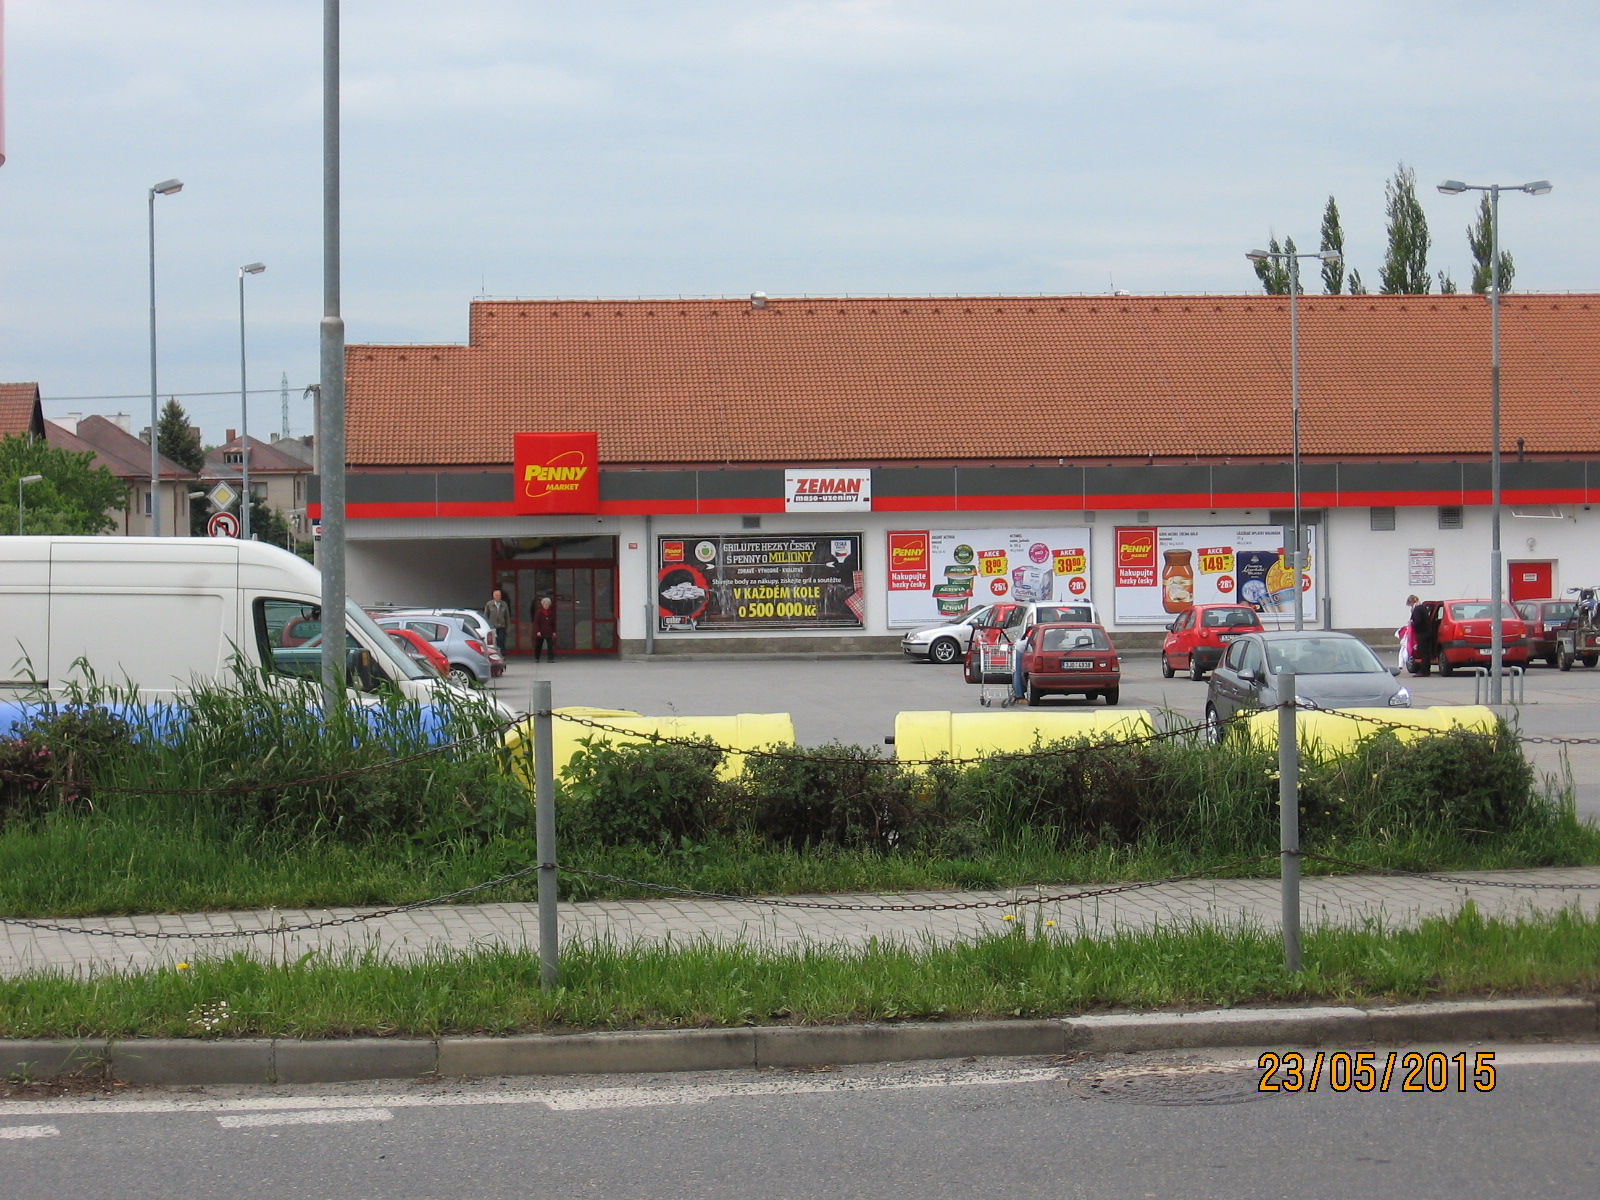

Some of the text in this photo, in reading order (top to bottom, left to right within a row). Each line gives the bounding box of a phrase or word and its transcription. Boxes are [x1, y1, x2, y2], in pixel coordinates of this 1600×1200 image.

[525, 465, 587, 481] PENNY
[796, 478, 862, 493] ZEMAN
[796, 494, 857, 502] maso-uzeniny
[761, 542, 788, 551] HEZKY
[789, 540, 817, 551] ČESKY
[1121, 544, 1152, 553] PENNY
[893, 548, 924, 556] PENNY
[983, 550, 1000, 558] AKCE
[733, 555, 760, 564] PENNY
[768, 551, 813, 563] MILIONY
[891, 573, 926, 581] Nakupujte
[1119, 569, 1153, 577] Nakupujte
[733, 584, 820, 599] V KAŽDÉM KOLE
[749, 602, 774, 617] 500
[776, 602, 803, 617] 000
[804, 604, 817, 616] Kč
